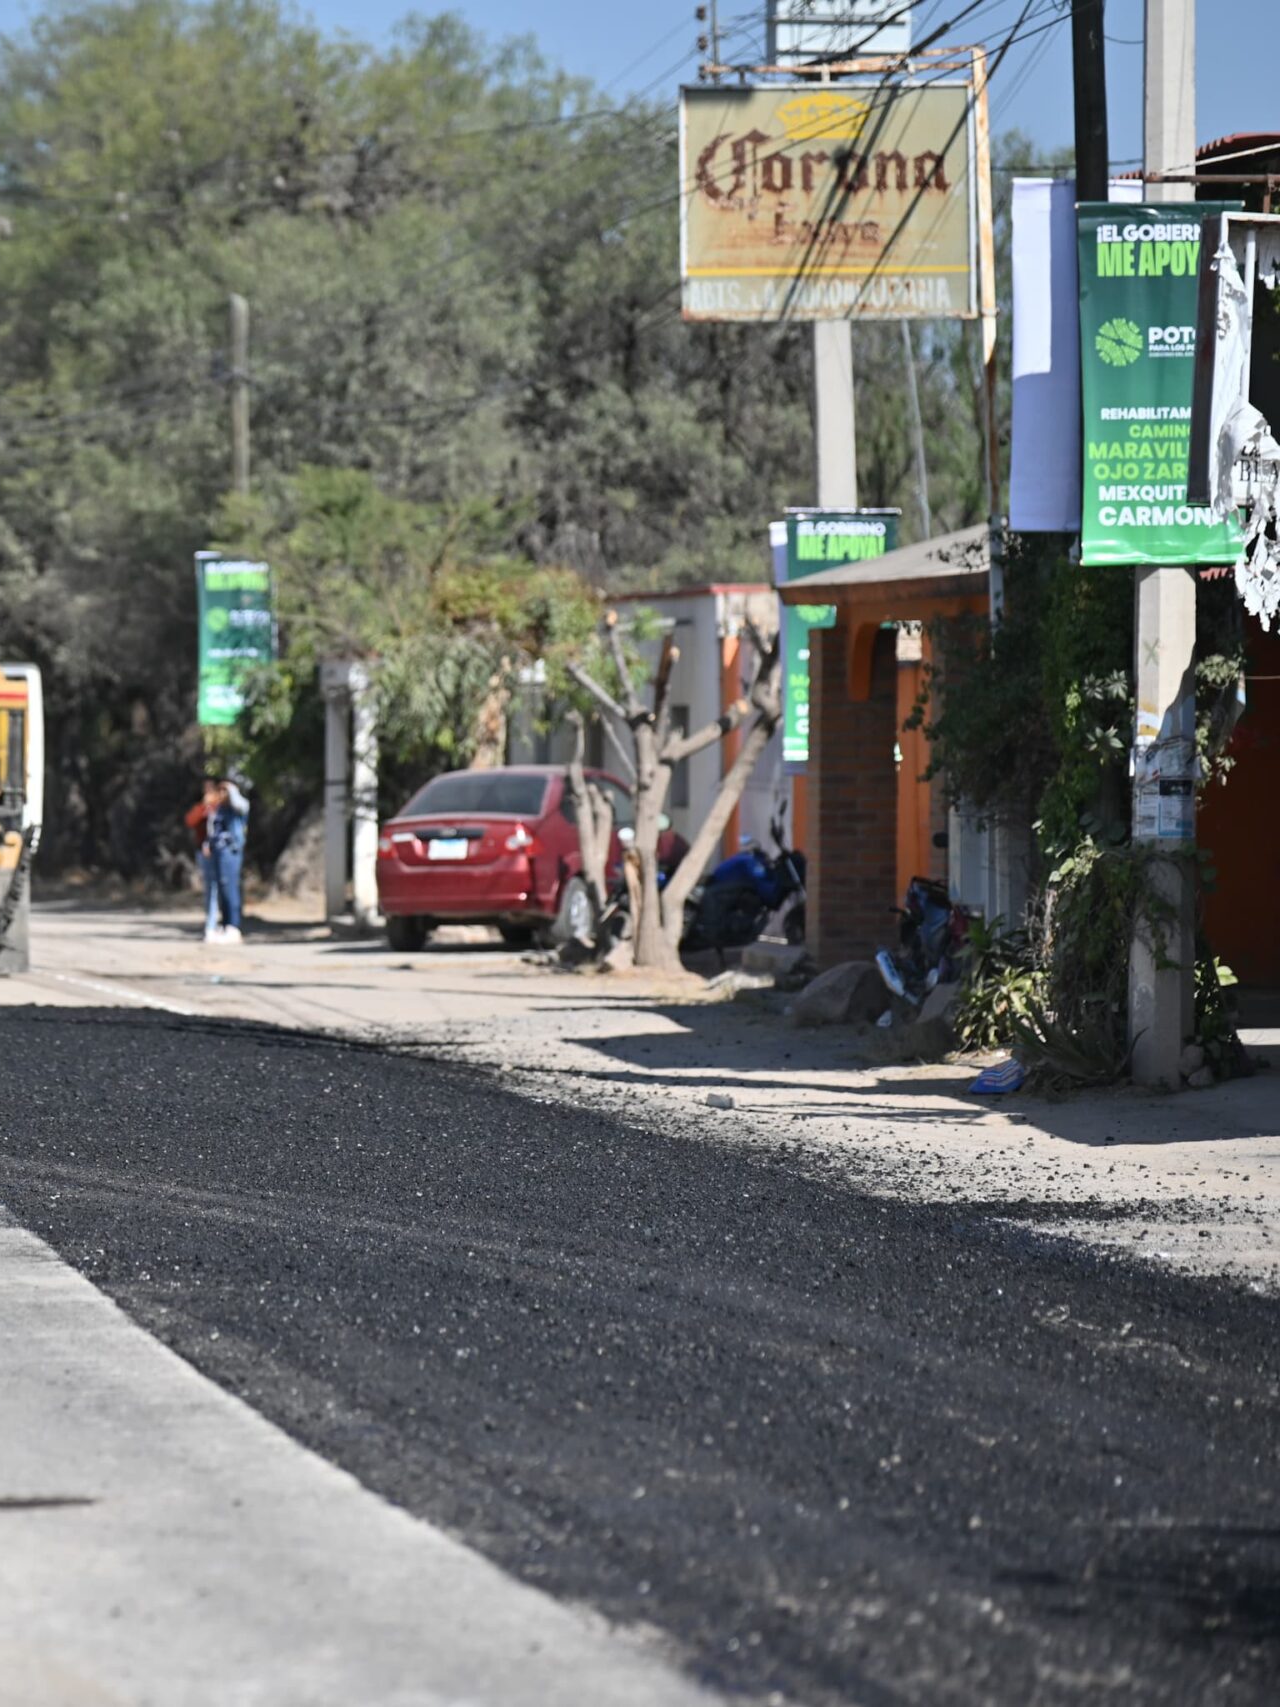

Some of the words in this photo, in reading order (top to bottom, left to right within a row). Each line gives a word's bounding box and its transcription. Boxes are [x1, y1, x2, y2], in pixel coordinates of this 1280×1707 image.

[696, 129, 951, 200] Corona
[1097, 224, 1122, 242] ¡EL
[1097, 242, 1135, 276] ME
[1148, 326, 1196, 344] POT
[1100, 407, 1192, 420] REHABILITAM
[1129, 424, 1191, 438] CAMIN
[1088, 441, 1190, 459] MARAVIL
[1093, 462, 1139, 480] OJO
[1098, 485, 1187, 502] MEXQUIT
